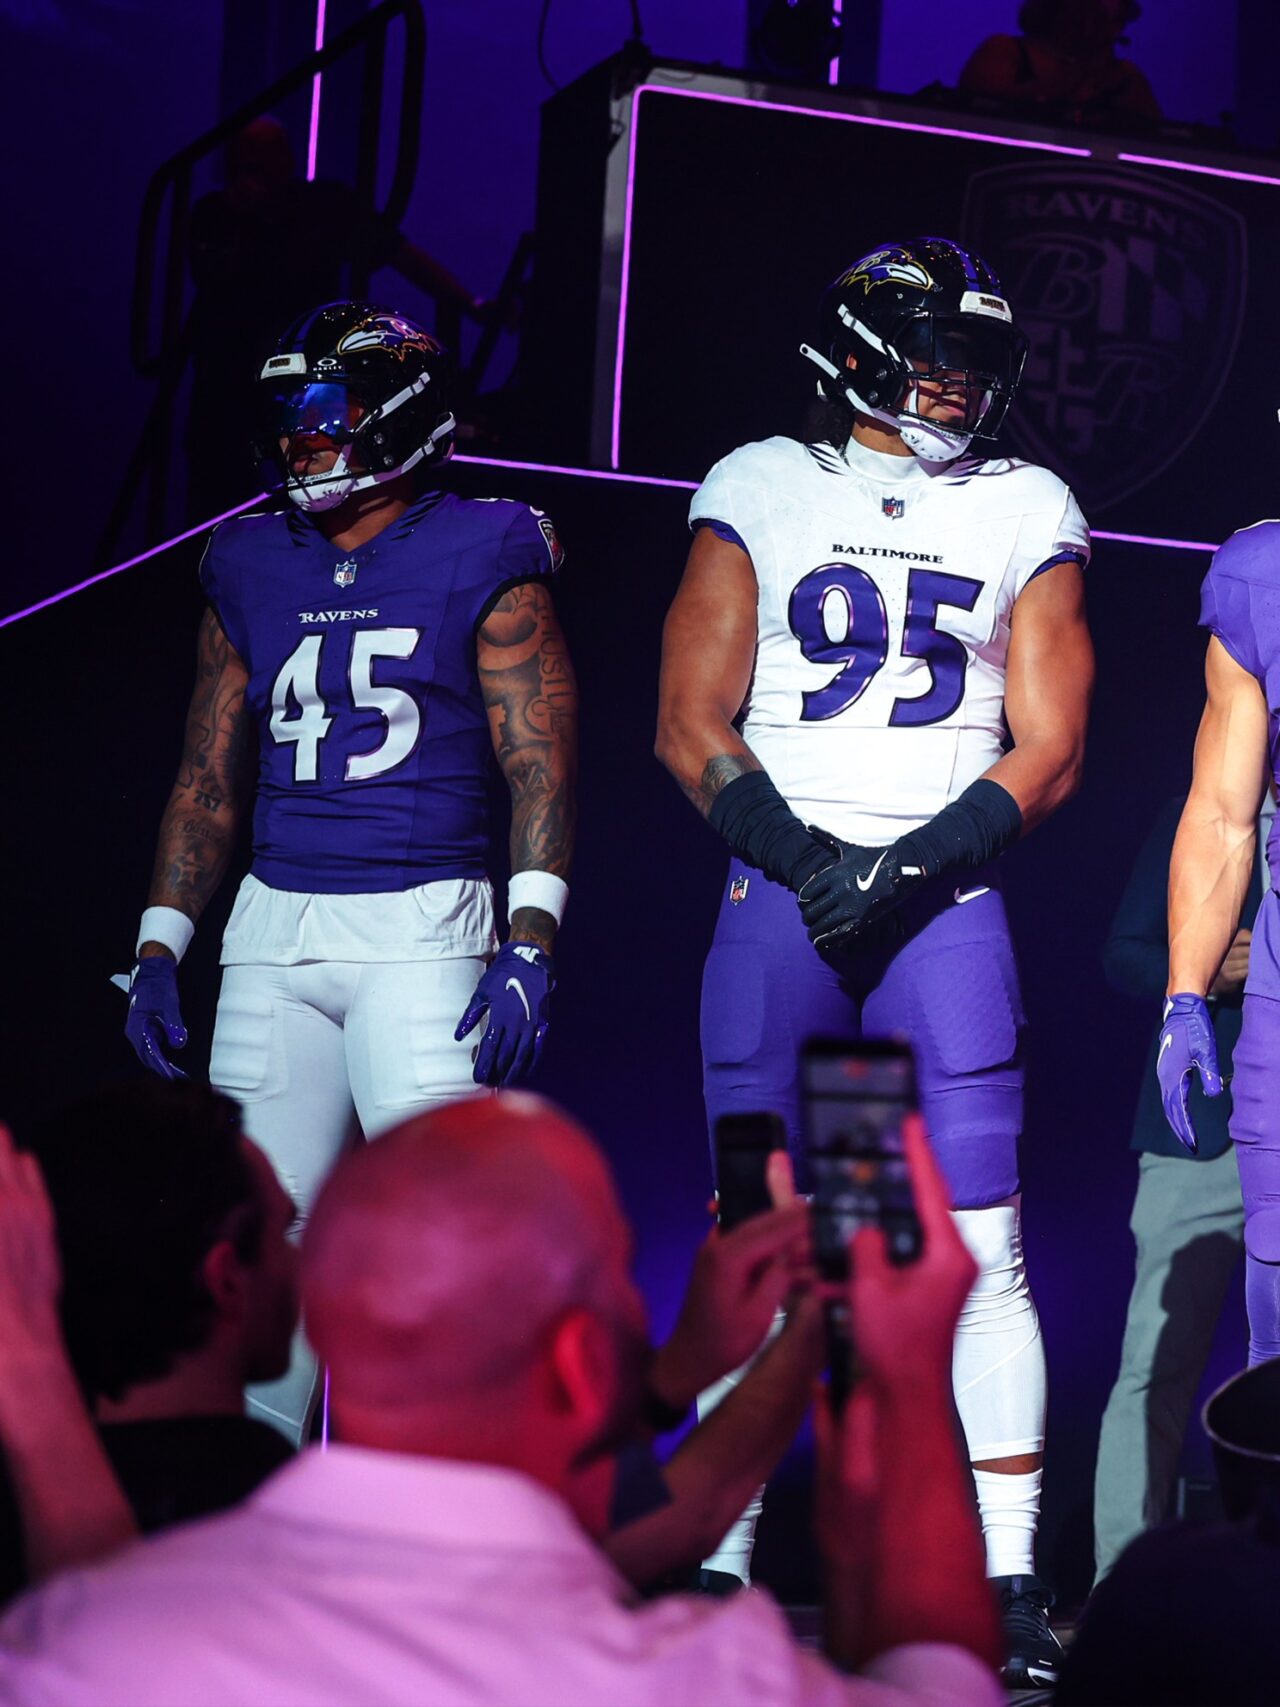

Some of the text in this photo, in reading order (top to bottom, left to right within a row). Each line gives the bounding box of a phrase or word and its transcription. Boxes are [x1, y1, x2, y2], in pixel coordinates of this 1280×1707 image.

[1010, 190, 1207, 247] RAVENS
[832, 544, 944, 564] BALTIMORE
[298, 609, 379, 624] RAVENS
[788, 562, 985, 728] 95
[267, 627, 423, 785] 45
